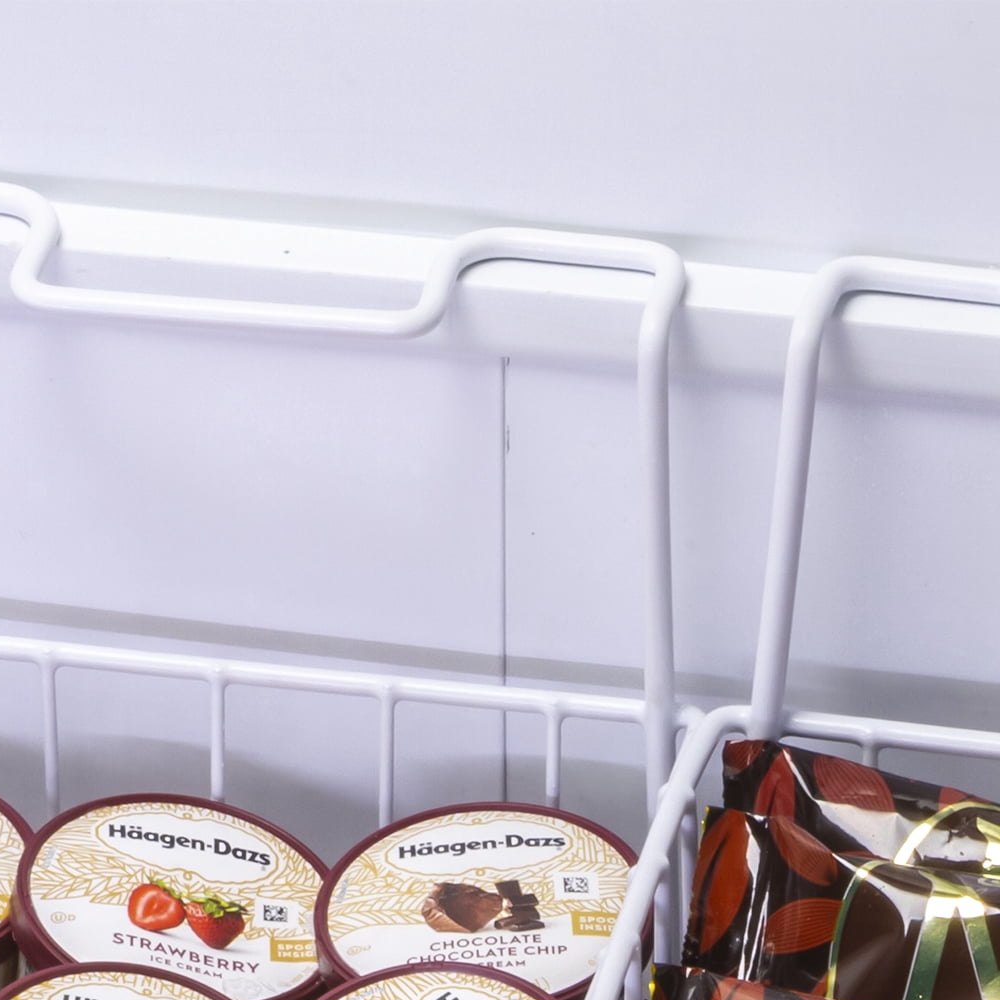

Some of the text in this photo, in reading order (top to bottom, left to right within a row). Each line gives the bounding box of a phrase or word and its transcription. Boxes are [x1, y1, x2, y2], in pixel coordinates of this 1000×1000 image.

[107, 824, 272, 867] Häagen-Dazs
[398, 834, 567, 860] Häagen-Dazs
[111, 932, 262, 975] STRAWBERRY
[429, 933, 543, 952] CHOCOLATE
[149, 955, 224, 980] ICE CREAM
[406, 945, 568, 967] CHOCOLATE CHIP
